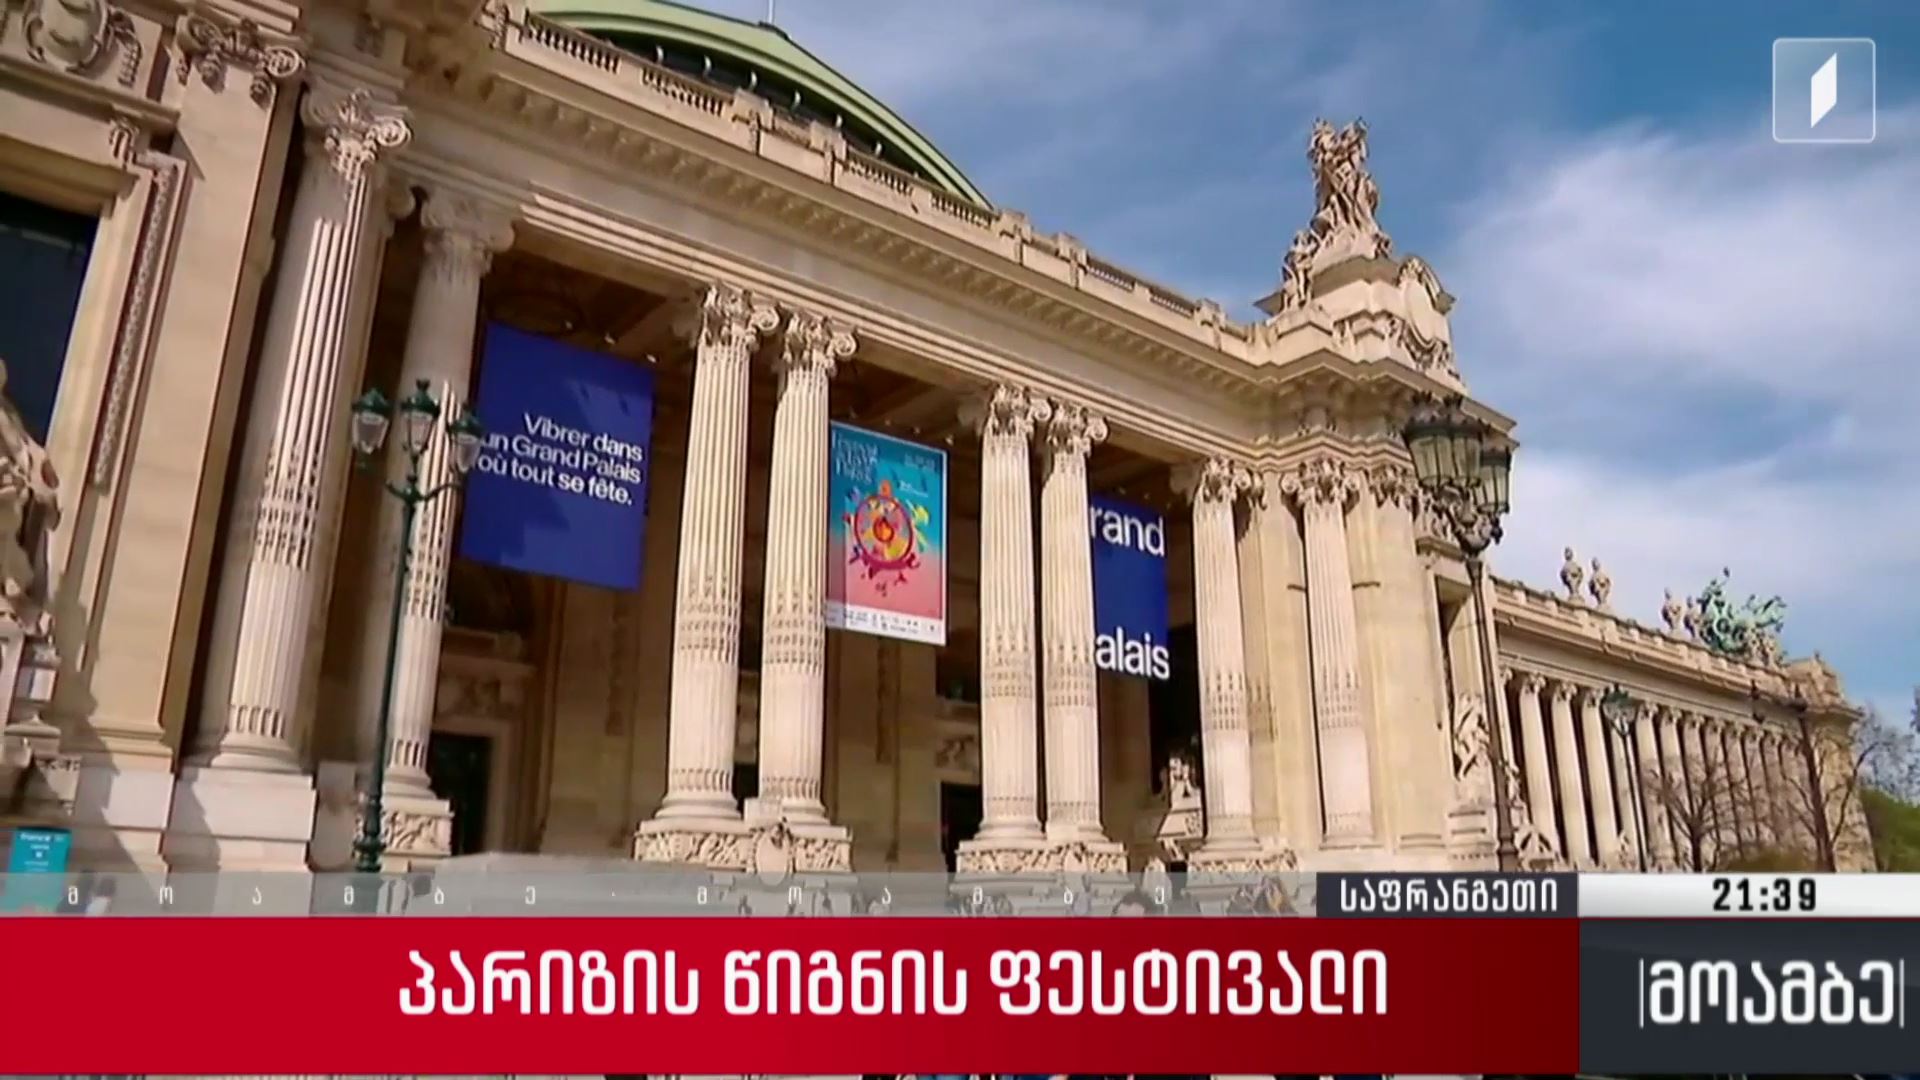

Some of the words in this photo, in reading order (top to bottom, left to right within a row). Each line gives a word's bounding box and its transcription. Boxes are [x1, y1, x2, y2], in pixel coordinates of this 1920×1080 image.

[512, 434, 580, 469] Grand
[582, 451, 641, 485] Palais
[524, 411, 591, 448] Vibrer
[593, 432, 643, 462] dans
[478, 453, 507, 475] où
[511, 457, 555, 488] tout
[558, 472, 585, 493] se
[588, 475, 632, 506] fête.
[1089, 505, 1165, 557] rand
[1096, 626, 1170, 680] alais
